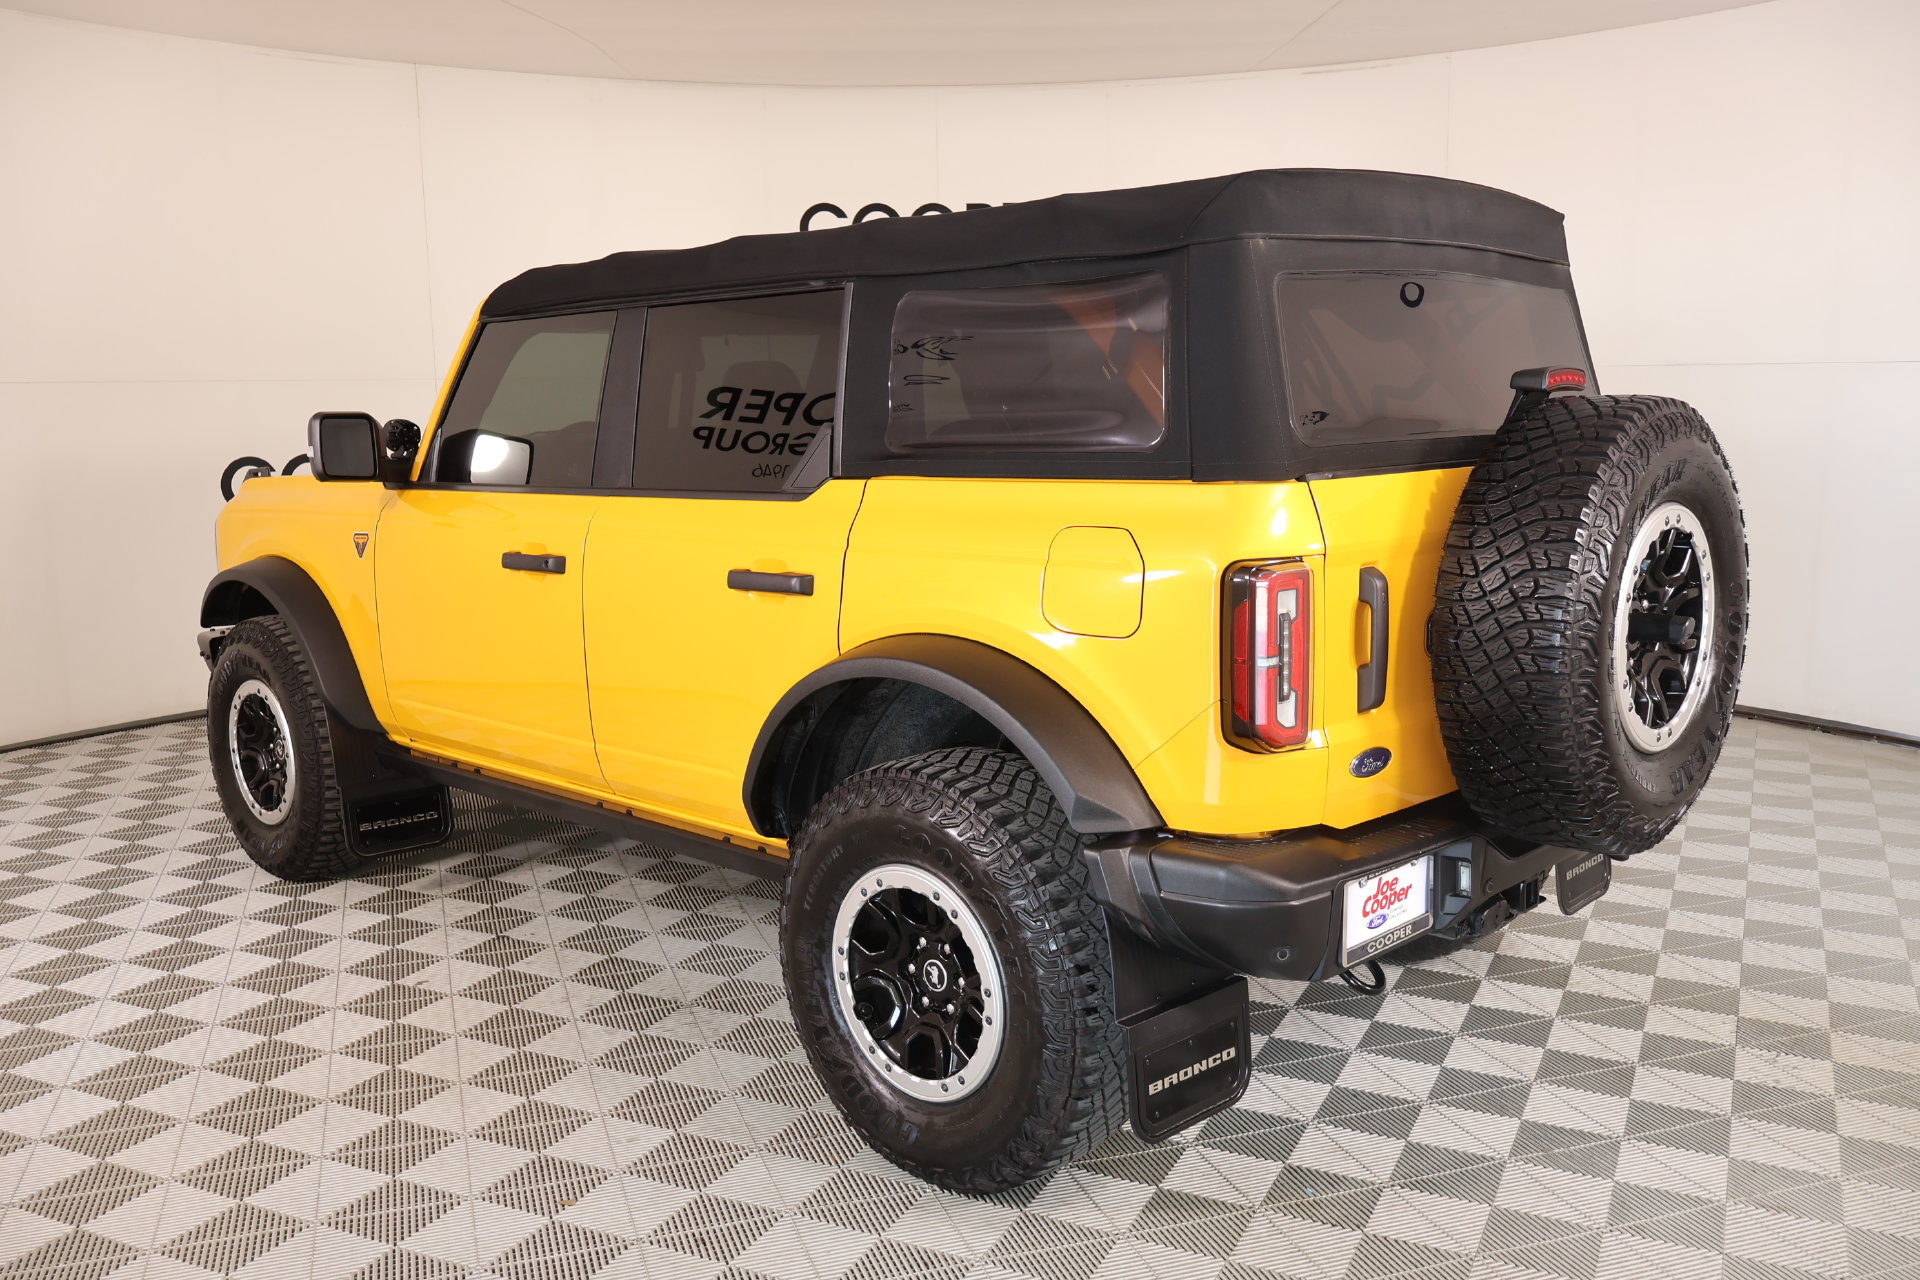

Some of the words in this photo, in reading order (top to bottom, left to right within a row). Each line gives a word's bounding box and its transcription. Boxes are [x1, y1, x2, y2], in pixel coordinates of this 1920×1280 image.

[360, 811, 438, 832] BRONCO
[1566, 853, 1604, 881] BRONCO
[1362, 883, 1413, 918] Cooper
[1372, 877, 1399, 900] Joe
[1367, 925, 1412, 953] COOPER
[1148, 1046, 1236, 1096] BRONCO
